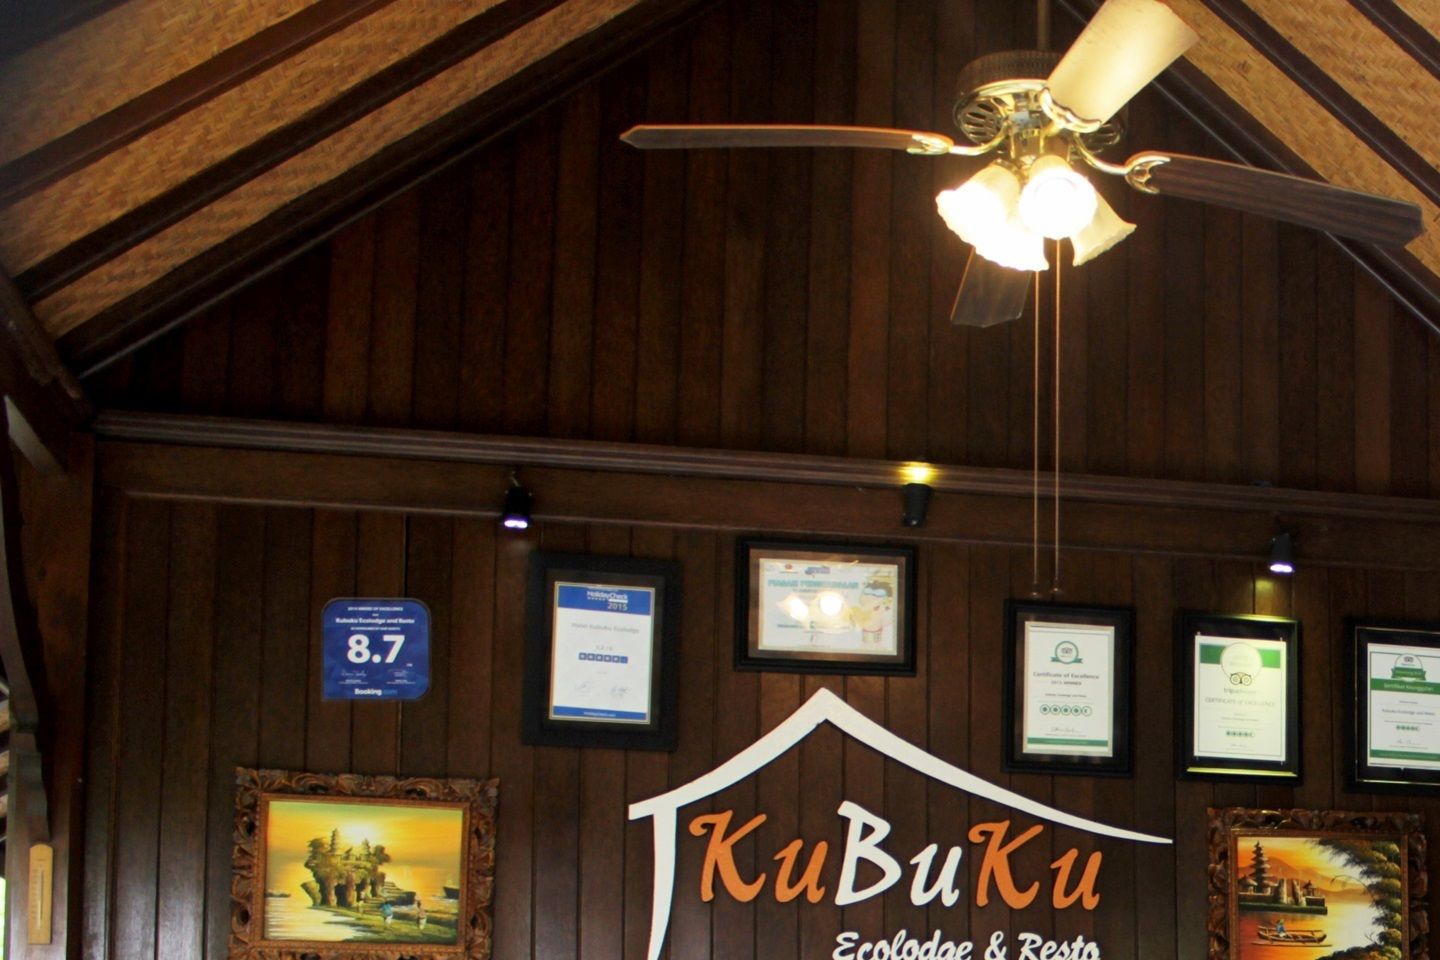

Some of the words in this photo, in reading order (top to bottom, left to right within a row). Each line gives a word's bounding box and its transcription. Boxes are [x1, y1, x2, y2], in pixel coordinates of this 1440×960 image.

[607, 602, 628, 612] 2015
[347, 634, 405, 663] 8.7
[688, 801, 1102, 910] KuBuKu
